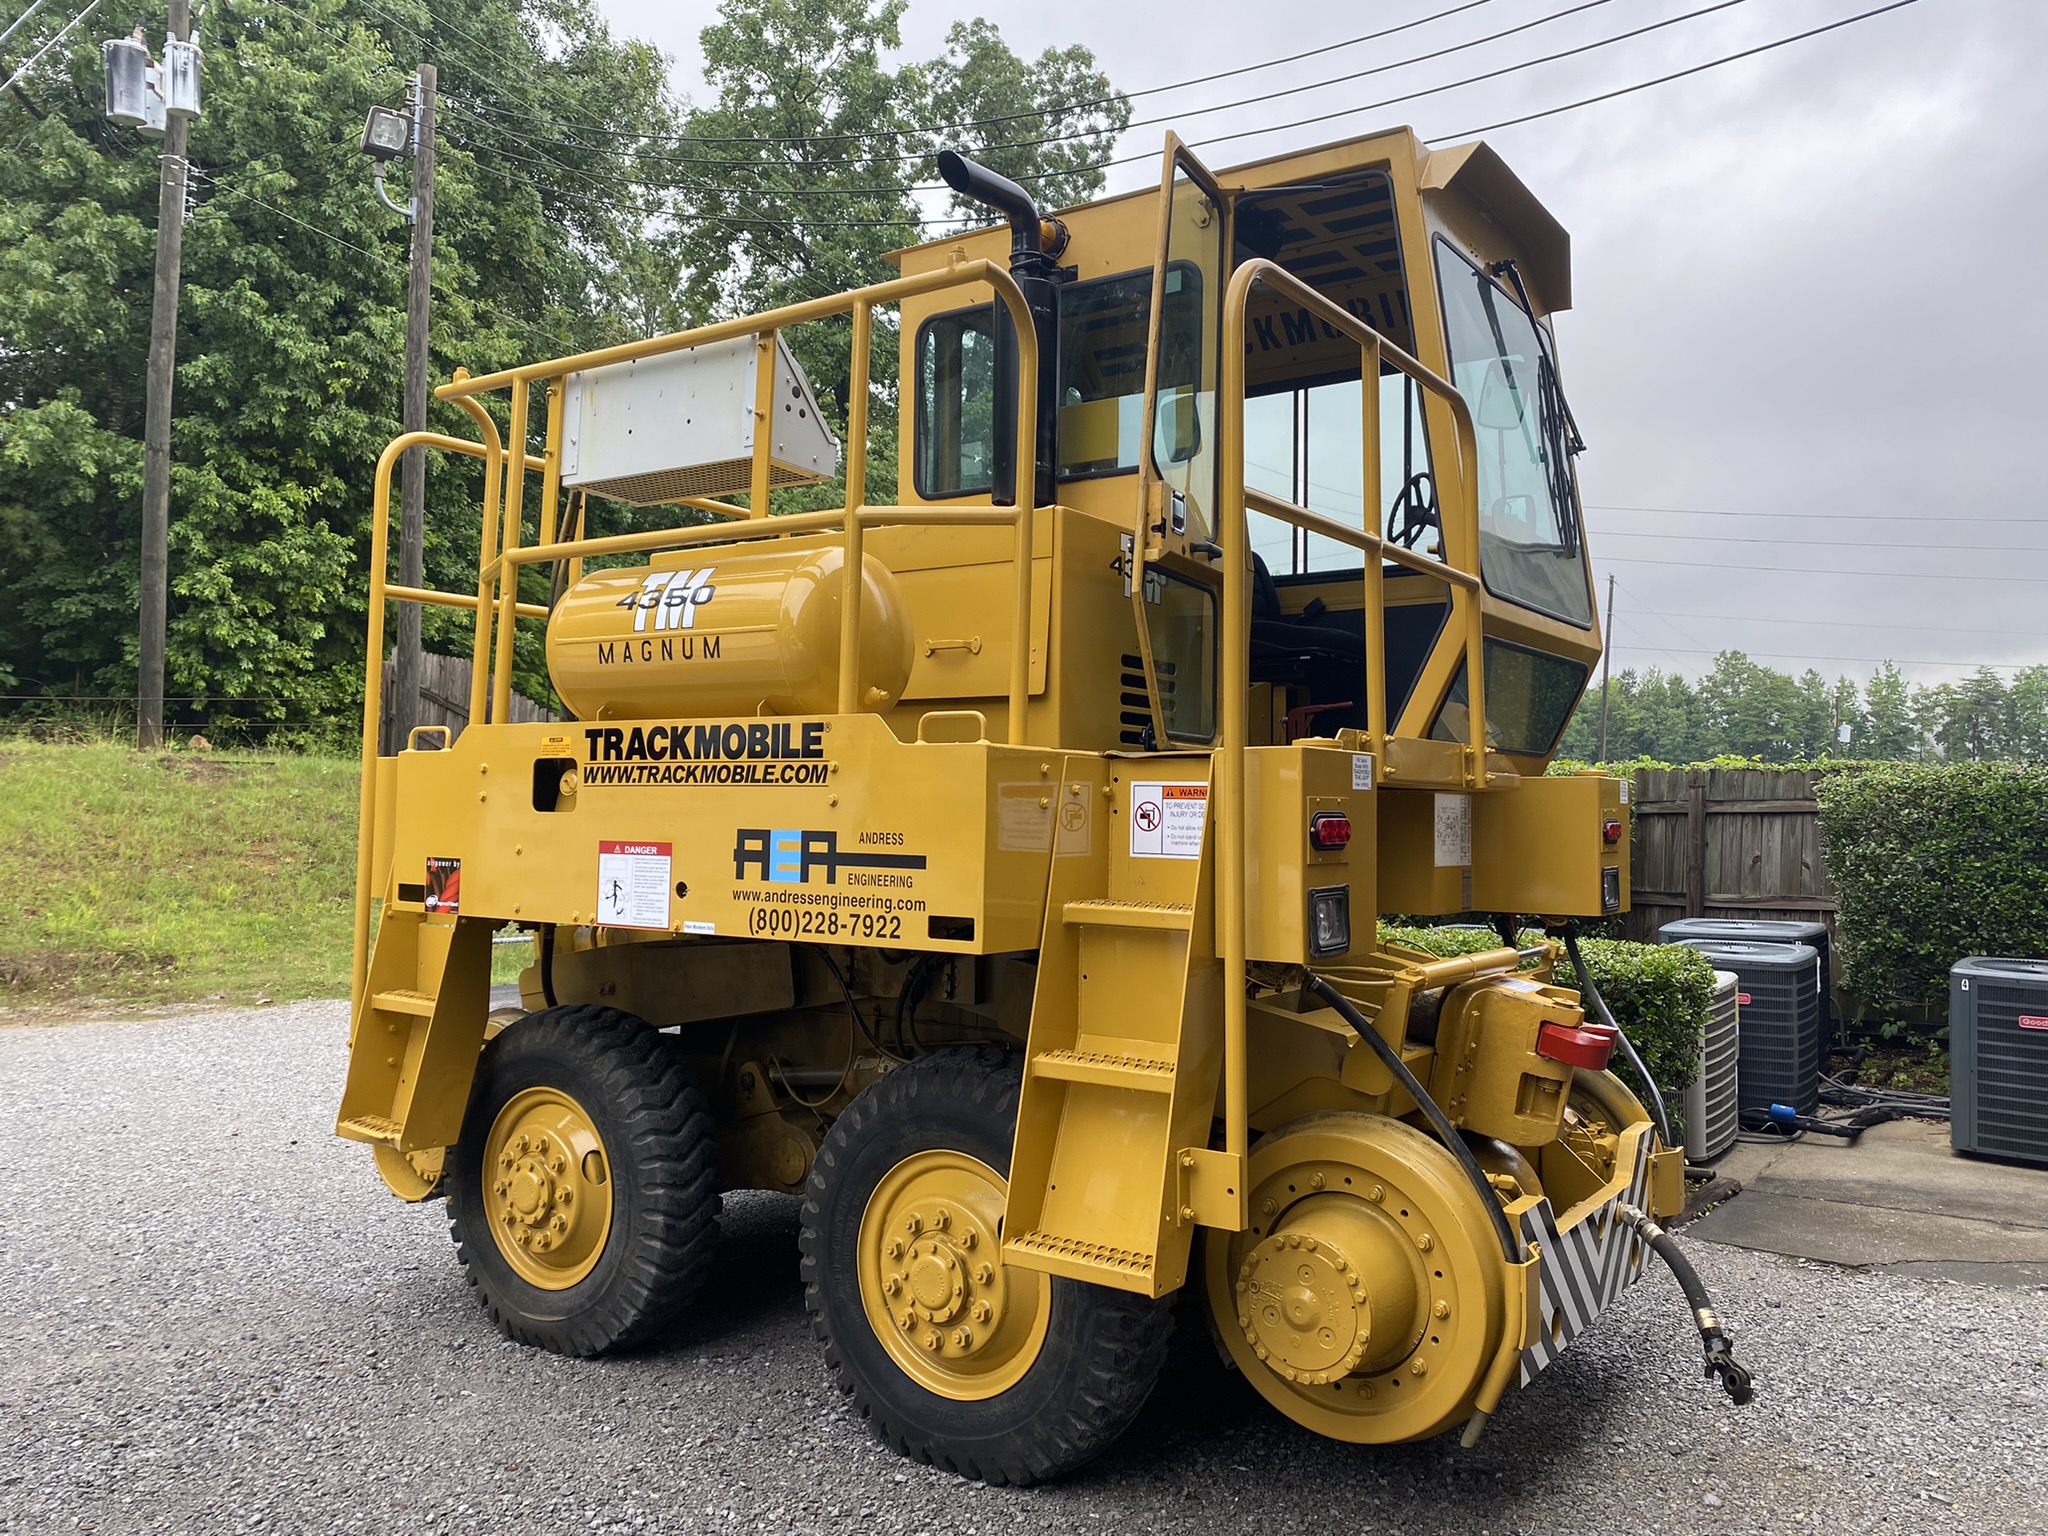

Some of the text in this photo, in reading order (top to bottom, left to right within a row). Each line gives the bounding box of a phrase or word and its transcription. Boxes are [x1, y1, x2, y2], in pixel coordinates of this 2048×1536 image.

[616, 585, 717, 611] 4350
[598, 635, 721, 665] MAGNUM
[583, 764, 829, 784] WWW.TRACKMOBILE.COM
[1179, 788, 1208, 797] WARNI
[859, 832, 904, 846] ANDRESS
[624, 845, 658, 855] DANGER
[848, 873, 913, 888] ENGINEERING
[732, 889, 926, 914] www.andressengineering.com
[749, 906, 902, 939] (800)228-7922
